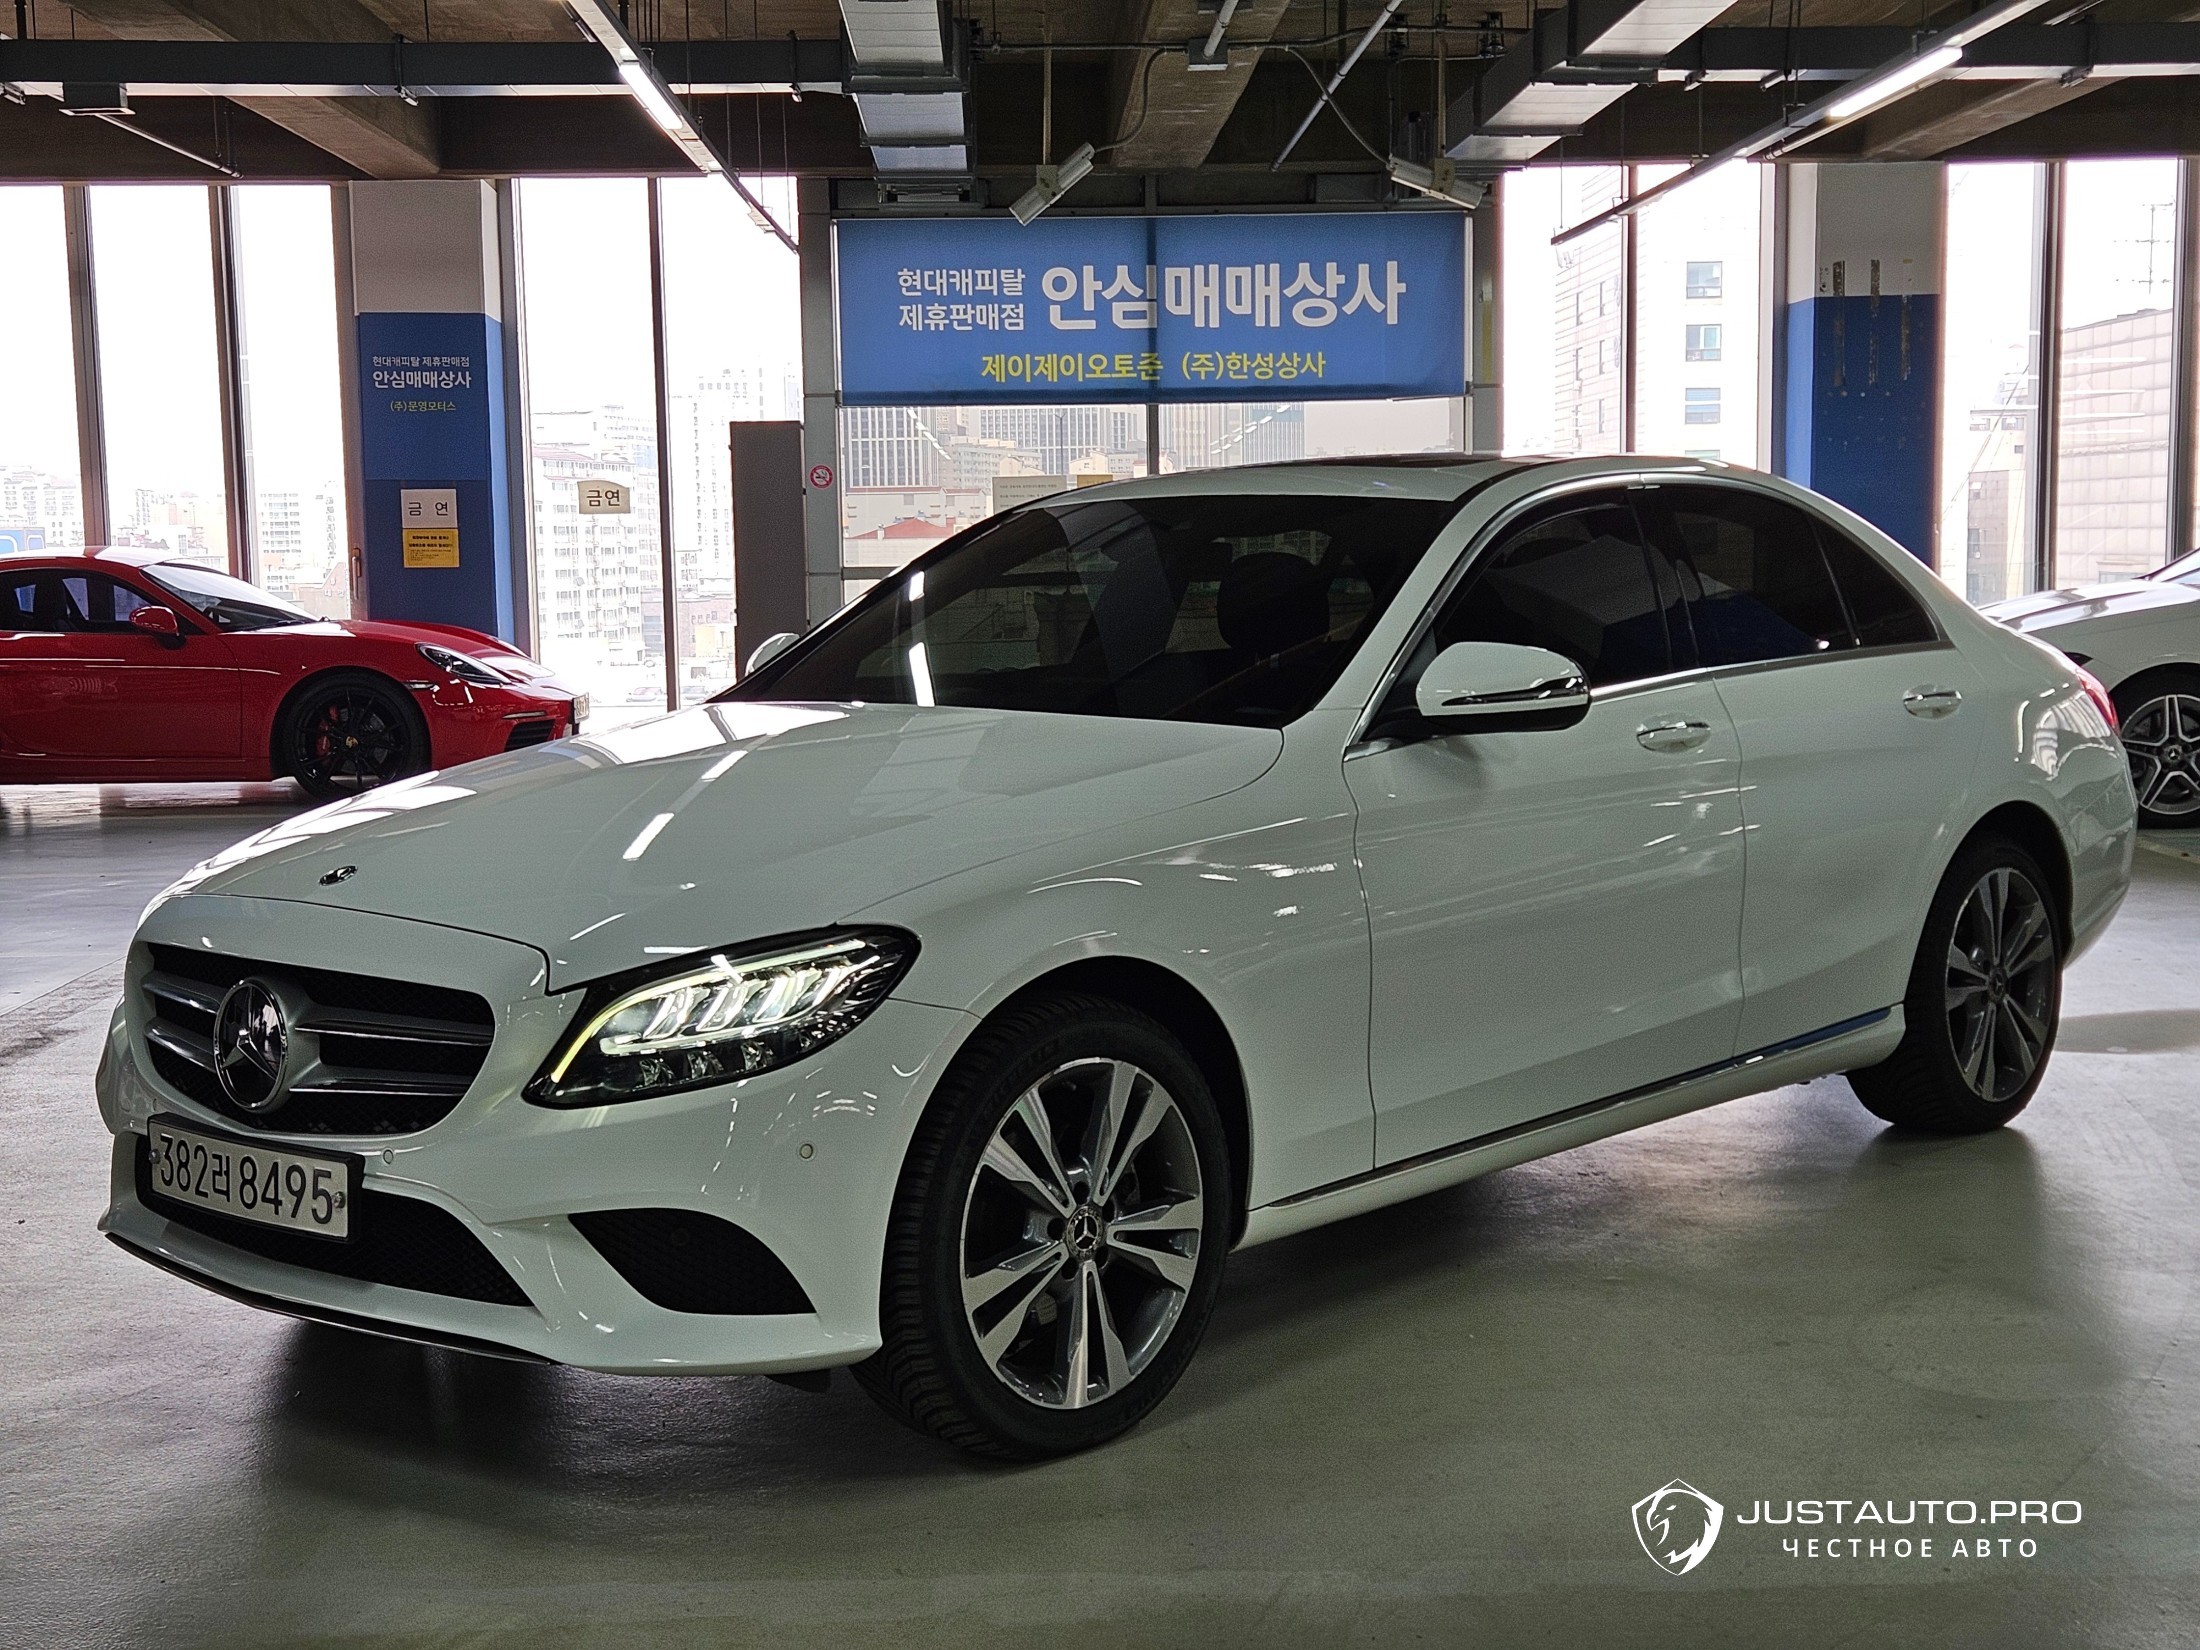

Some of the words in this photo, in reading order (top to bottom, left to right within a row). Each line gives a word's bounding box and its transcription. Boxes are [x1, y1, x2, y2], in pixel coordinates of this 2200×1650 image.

[897, 268, 1026, 296] 현대캐피탈
[1041, 260, 1407, 330] 안심매매상사
[898, 302, 1025, 331] 제휴판매점
[372, 356, 420, 367] 현대캐피탈
[422, 356, 470, 367] 제휴판매점
[981, 352, 1164, 383] 제이제이오토준
[1181, 351, 1327, 381] (주)한성상사
[372, 370, 472, 389] 안심매매상사
[390, 400, 457, 412] (주)문영모터스
[586, 489, 620, 507] 금연
[160, 1133, 231, 1203] 382러
[239, 1155, 333, 1224] 8495
